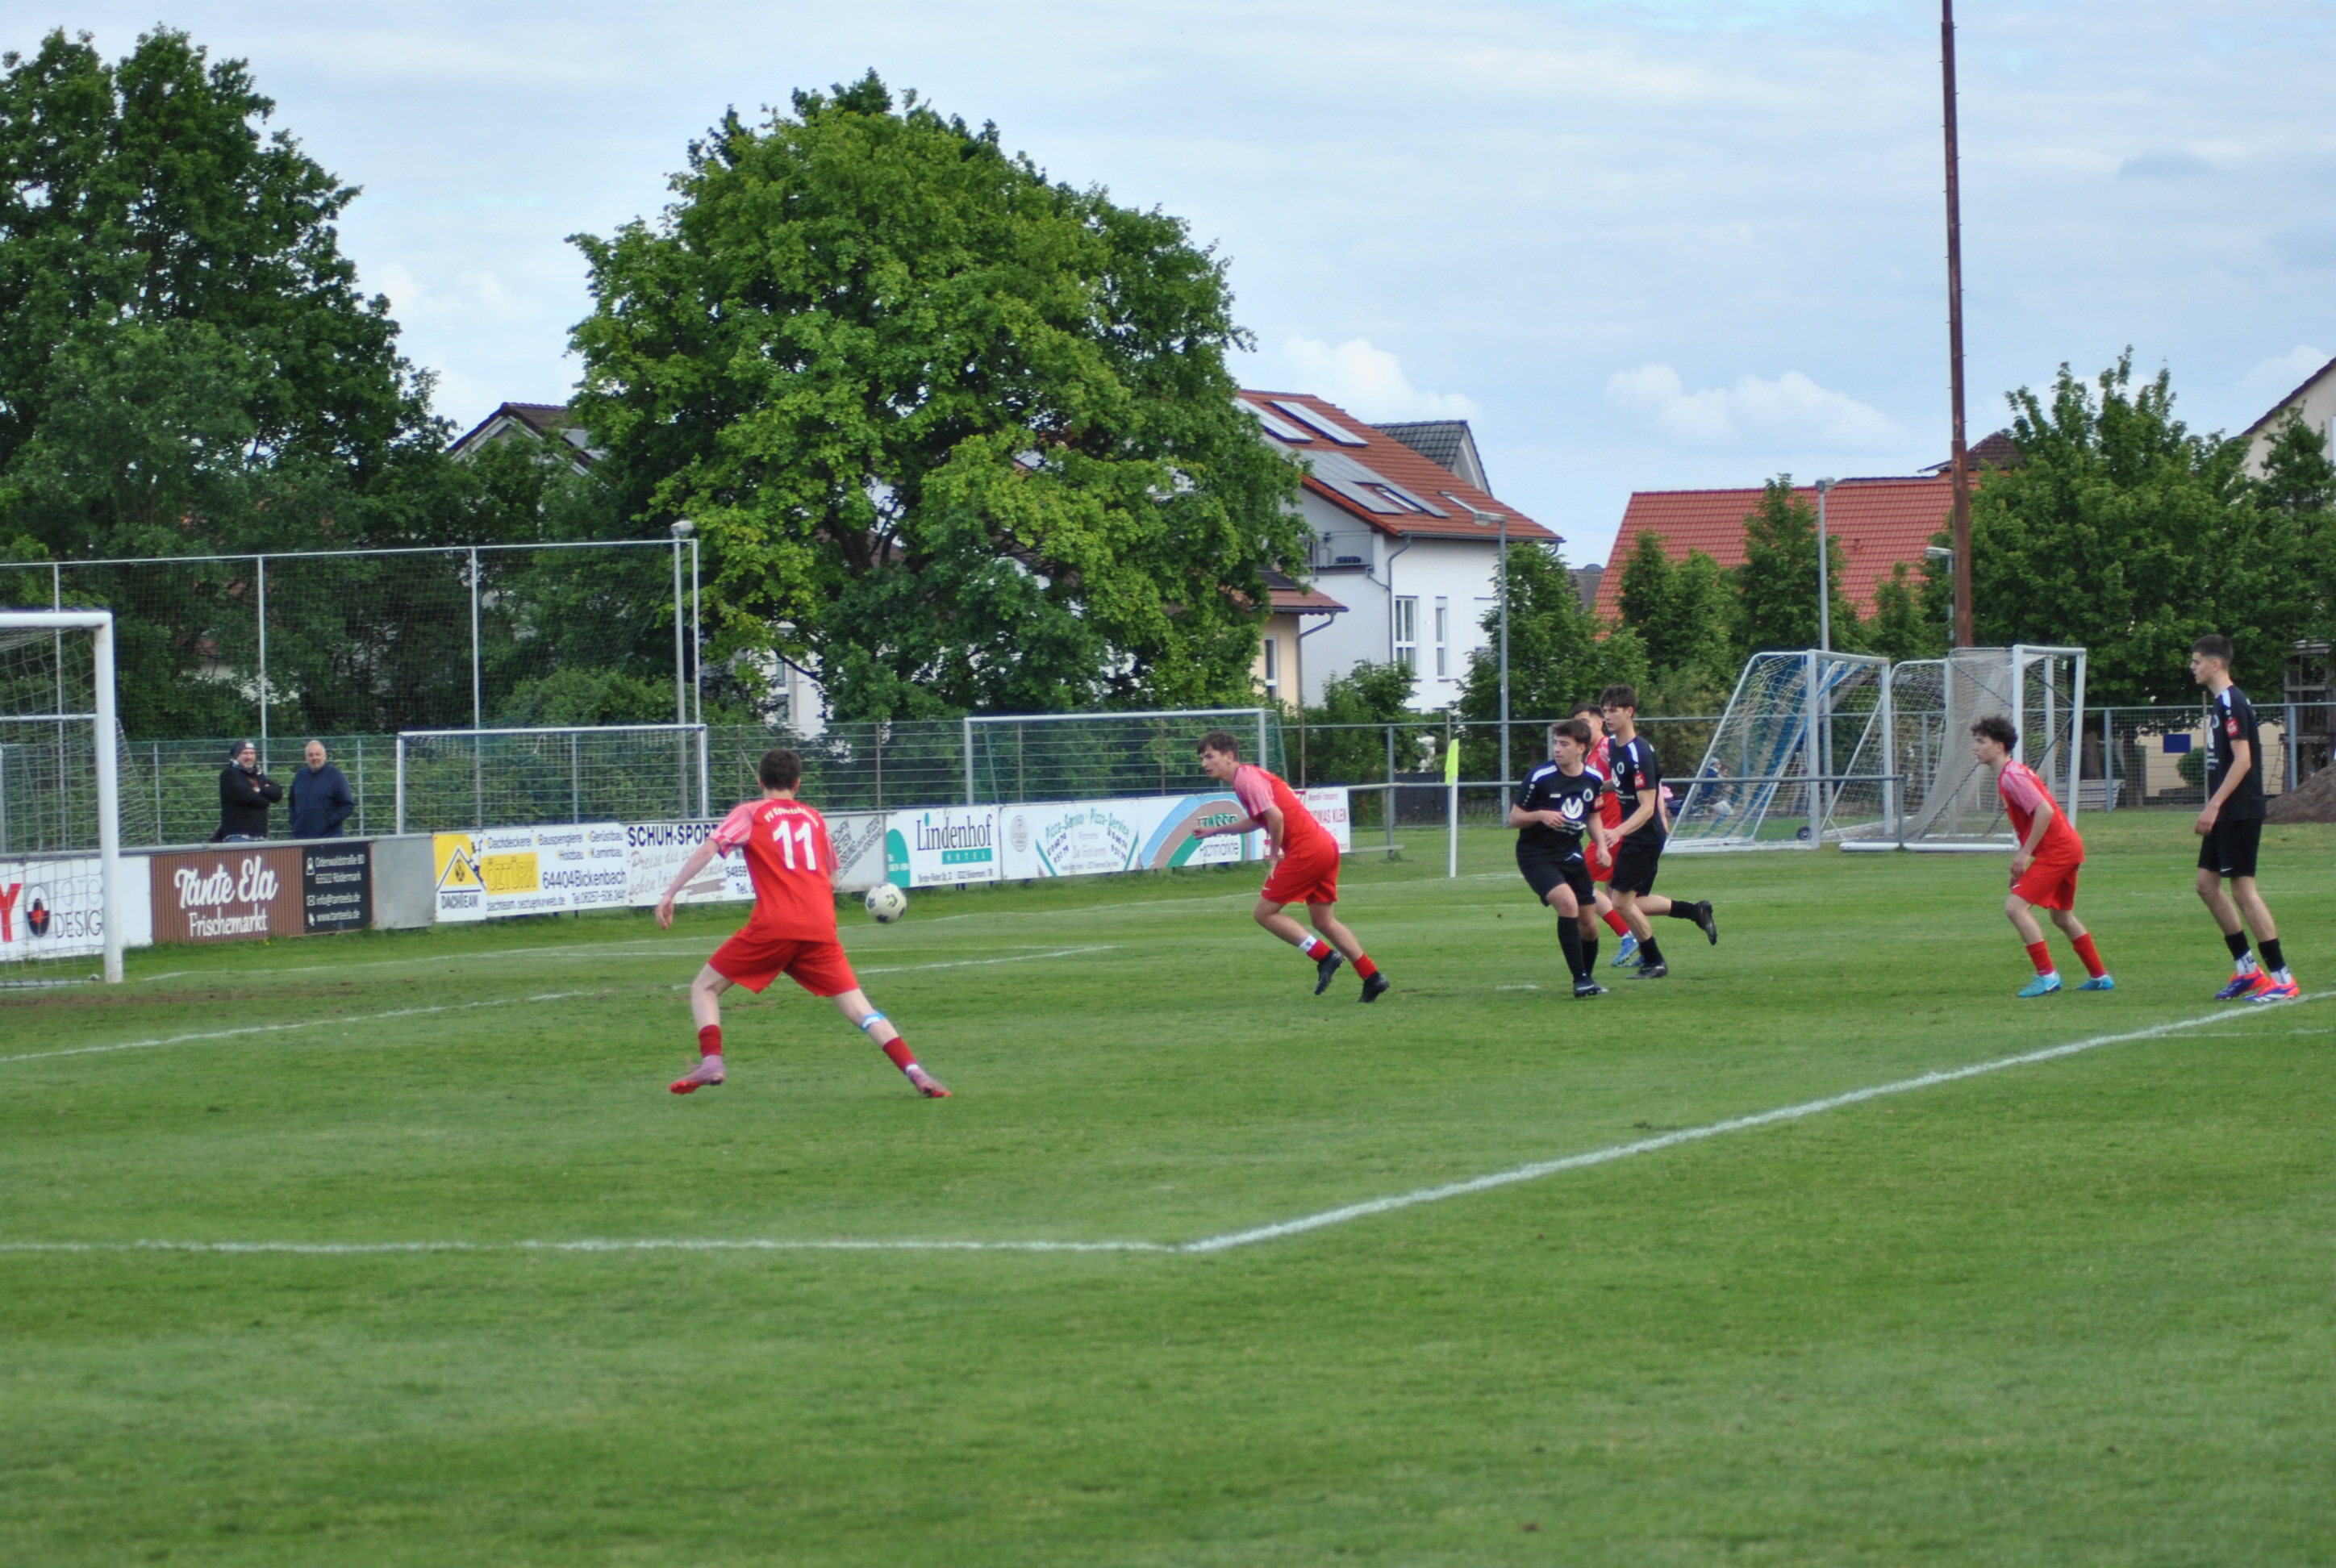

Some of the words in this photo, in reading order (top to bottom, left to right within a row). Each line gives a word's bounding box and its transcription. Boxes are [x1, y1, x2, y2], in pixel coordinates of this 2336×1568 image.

[764, 810, 774, 823] FV
[916, 811, 992, 851] Lindenhof
[488, 836, 532, 849] Dachdeckerei
[538, 832, 583, 847] Bauspenglerei
[590, 830, 624, 843] Gerüstbau
[560, 849, 584, 861] Holzbau
[591, 847, 623, 859] Kaminbau
[773, 819, 816, 870] 11
[174, 863, 236, 909] Tante
[238, 855, 279, 903] Ela
[487, 856, 537, 891] ÖZTÜRK
[441, 891, 478, 910] DACHTEAM
[55, 909, 102, 939] DESIG
[189, 903, 269, 937] Frischemarkt
